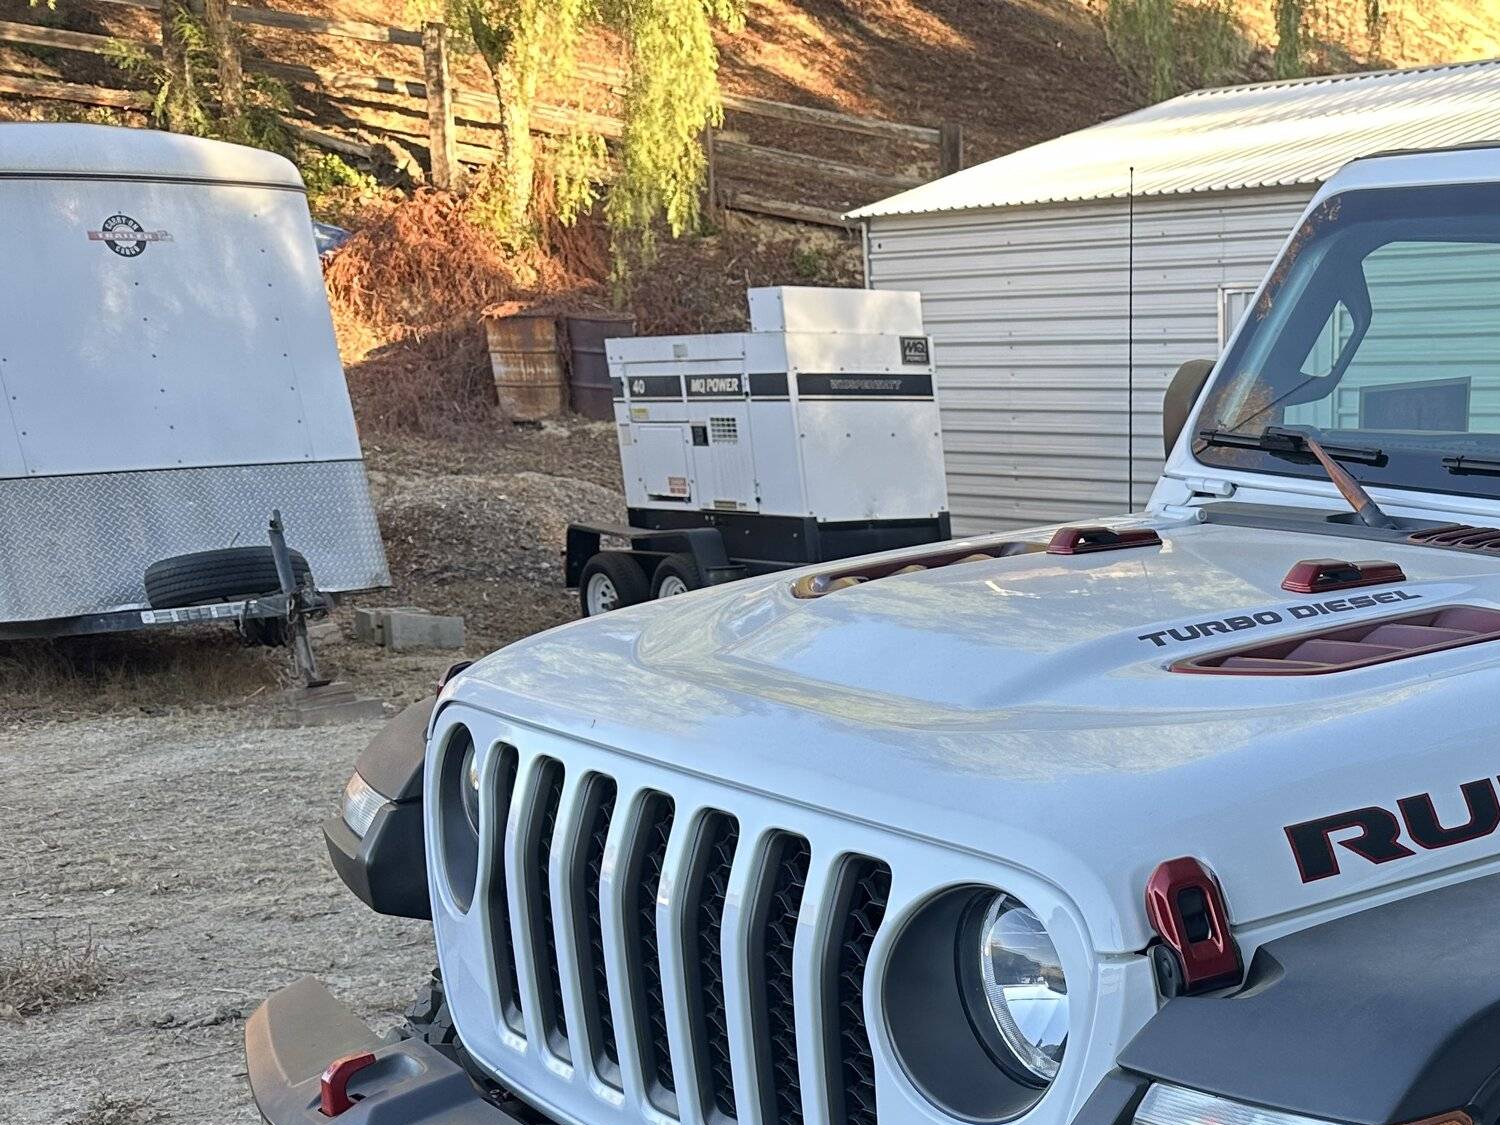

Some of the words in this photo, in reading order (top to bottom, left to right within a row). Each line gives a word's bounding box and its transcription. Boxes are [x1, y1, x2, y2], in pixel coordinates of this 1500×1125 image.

[632, 379, 646, 394] 40
[690, 379, 706, 394] MQ
[706, 378, 739, 393] POWER
[1137, 611, 1283, 648] TURBO
[1286, 590, 1423, 620] DIESEL
